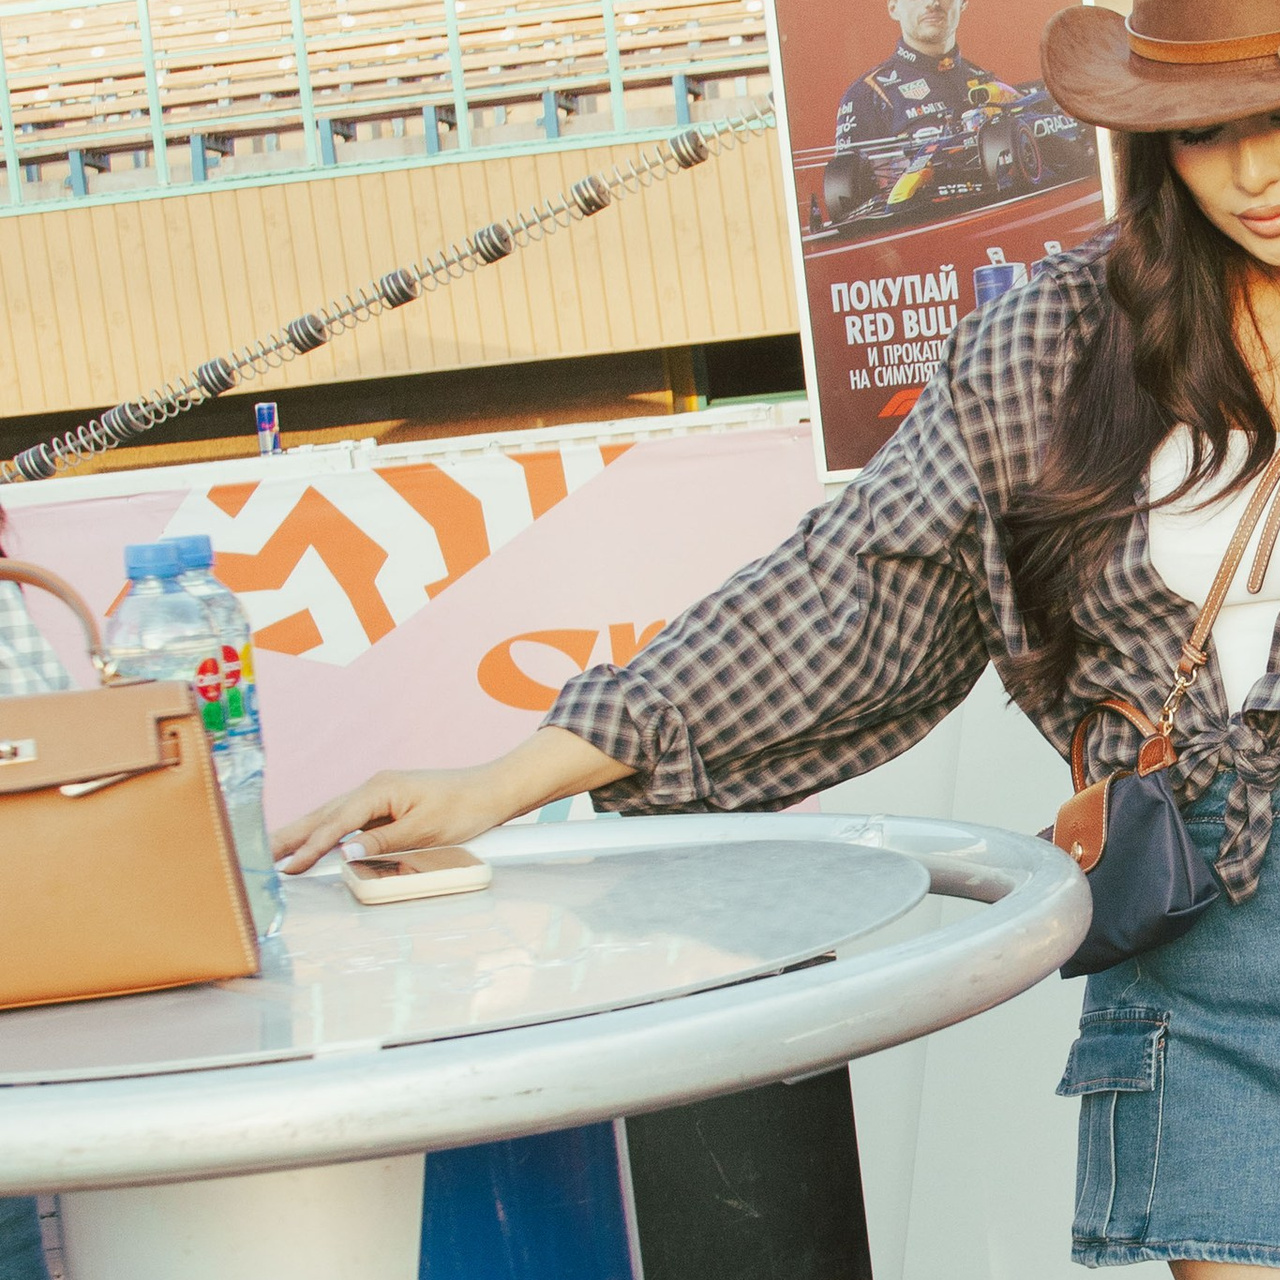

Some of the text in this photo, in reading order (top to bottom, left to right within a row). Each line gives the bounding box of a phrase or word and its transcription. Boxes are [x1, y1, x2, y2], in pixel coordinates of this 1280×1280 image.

[830, 264, 960, 314] ПОКУПАЙ
[844, 311, 896, 346] RED
[867, 338, 947, 368] И ПРОКАТИ
[850, 360, 941, 391] НА СИМУЛЯТ
